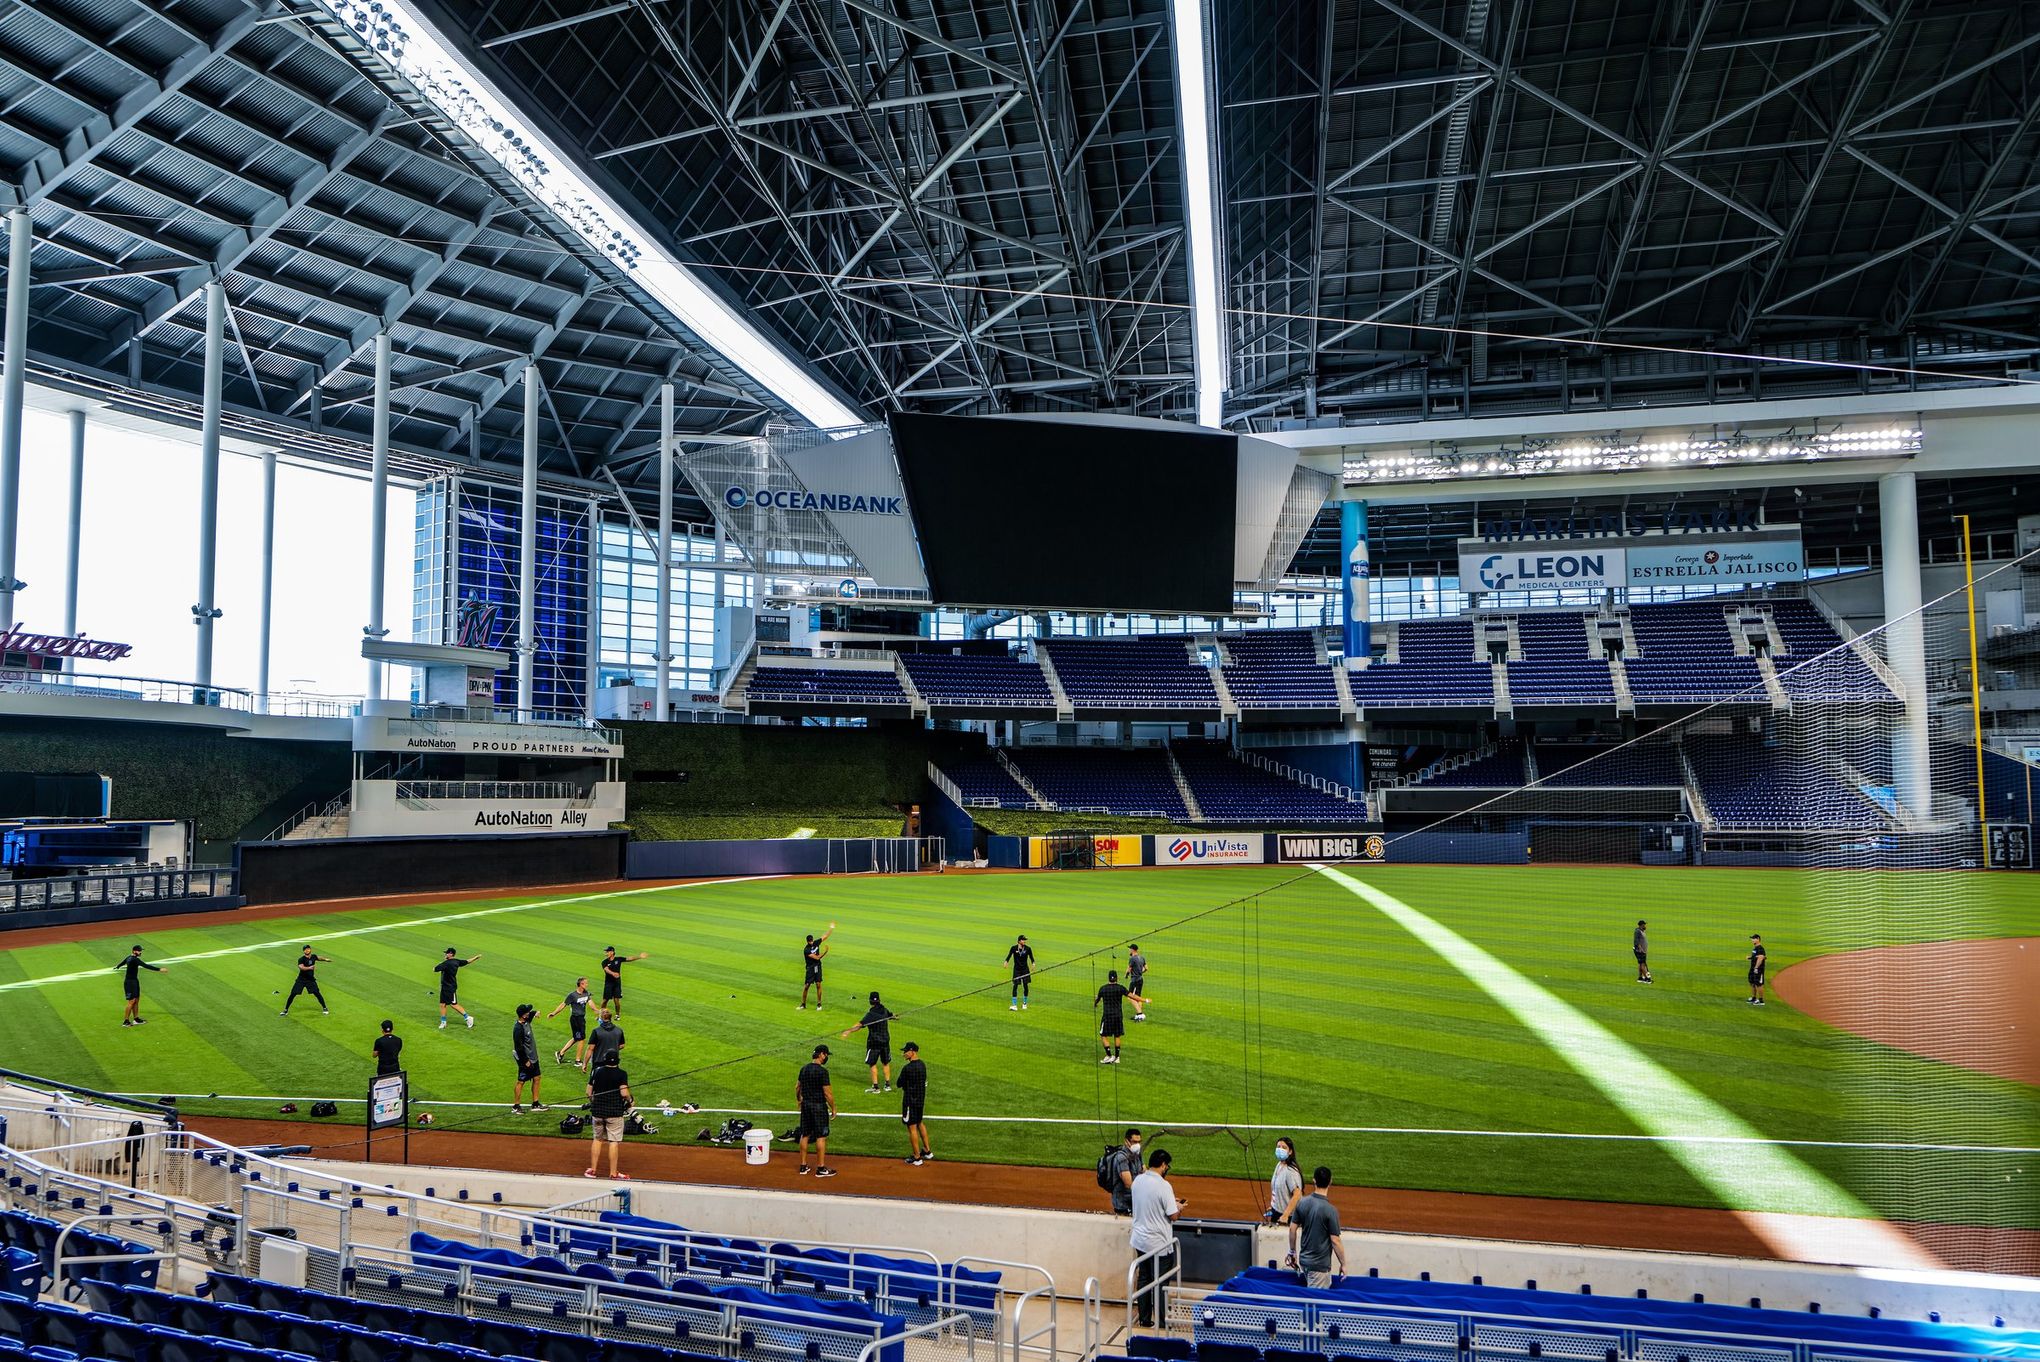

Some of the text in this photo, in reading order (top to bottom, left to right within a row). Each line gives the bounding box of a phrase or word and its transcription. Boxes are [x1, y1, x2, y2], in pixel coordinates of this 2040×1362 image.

[1484, 508, 1759, 543] MARLINS PARK
[1518, 555, 1604, 579] LEON
[1633, 562, 1798, 578] ESTRELLA JALISCO
[841, 583, 856, 594] 42
[1519, 580, 1604, 589] MEDICAL CENTERS
[407, 738, 456, 749] AutoNation
[473, 742, 518, 751] PROUD
[524, 743, 575, 753] PARTNERS
[474, 811, 587, 827] AutoNation Alley
[1192, 839, 1248, 858] UniVista
[1284, 839, 1319, 858] WIN
[1322, 838, 1358, 857] BIG!
